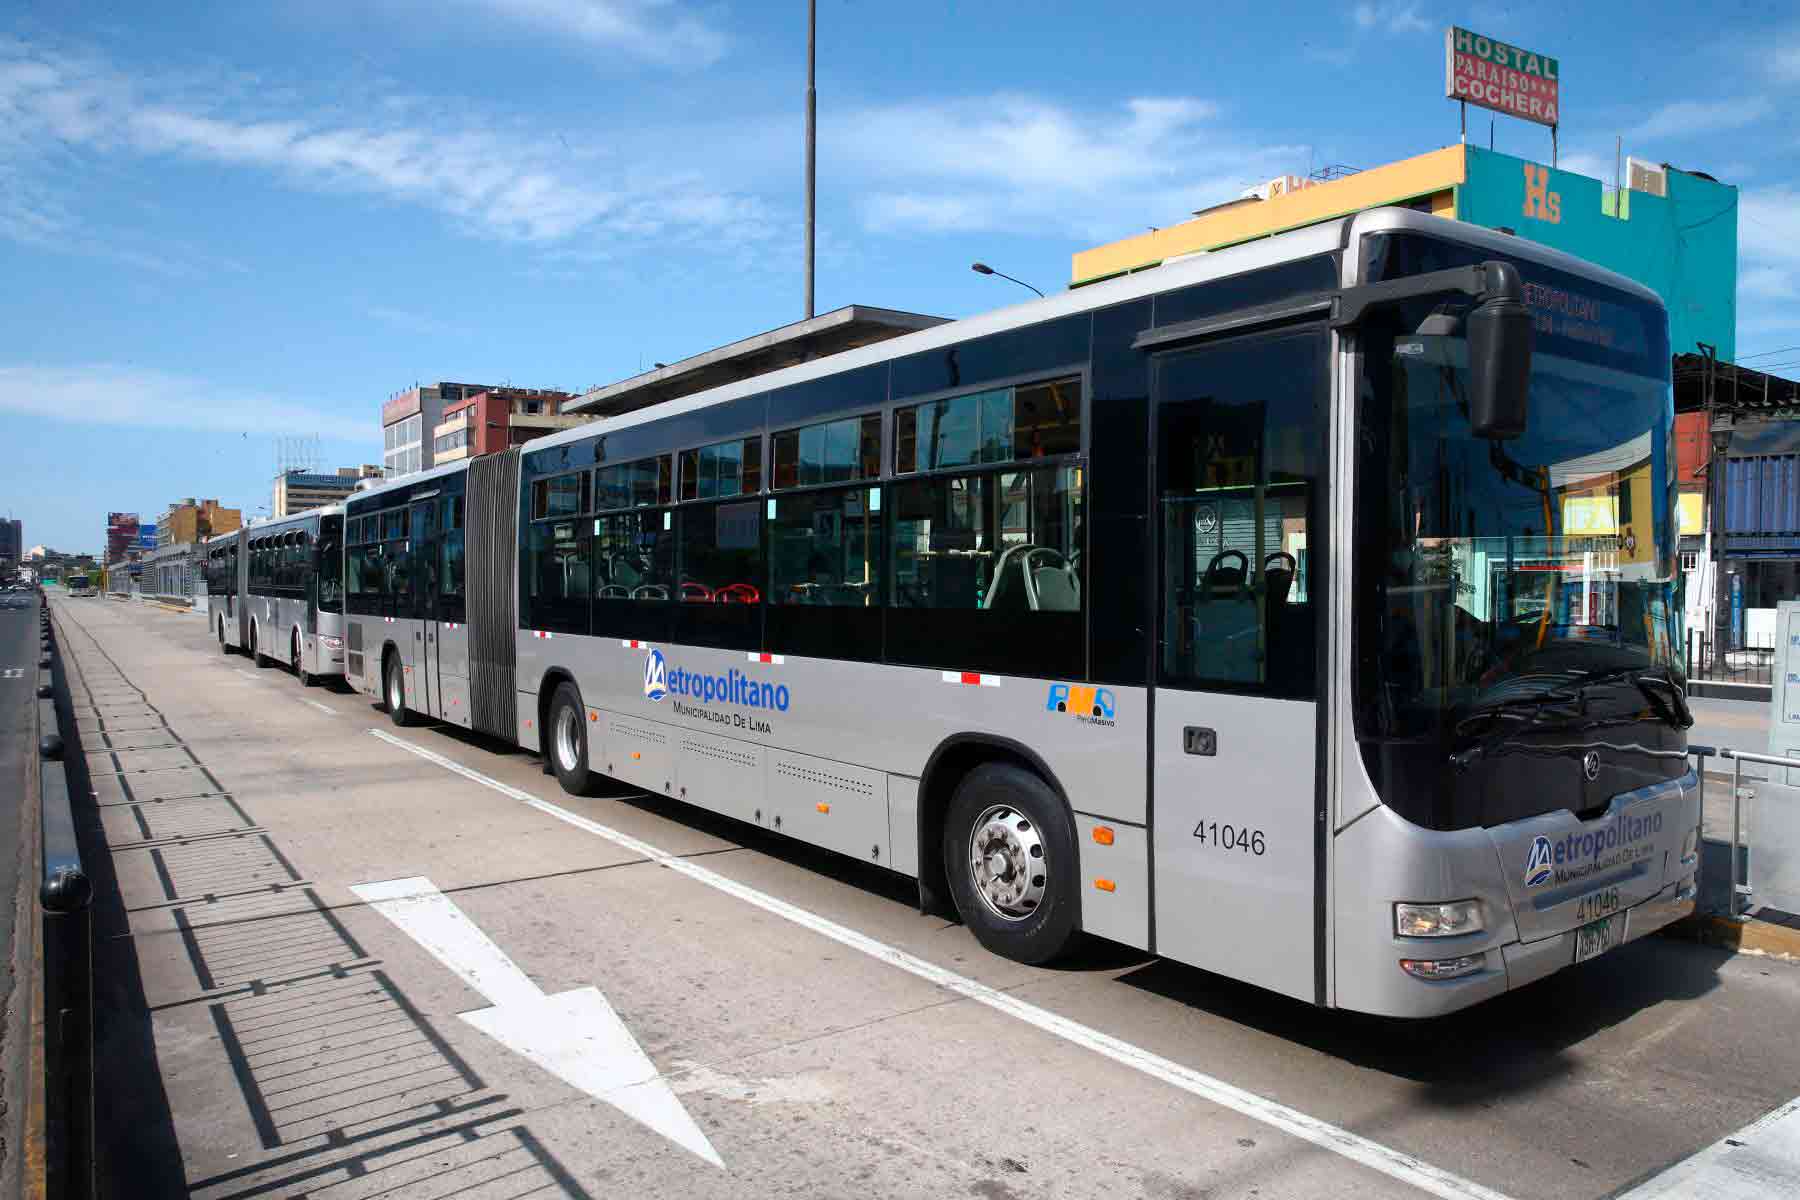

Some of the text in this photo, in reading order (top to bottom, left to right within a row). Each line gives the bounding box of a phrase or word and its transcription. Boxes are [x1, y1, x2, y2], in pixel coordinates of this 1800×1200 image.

[1455, 30, 1556, 80] HOSTAL
[1455, 54, 1529, 92] PARAISO
[1454, 75, 1557, 120] COCHERA
[749, 717, 771, 735] LIMA
[1193, 819, 1265, 856] 41046
[1576, 886, 1618, 919] 41046
